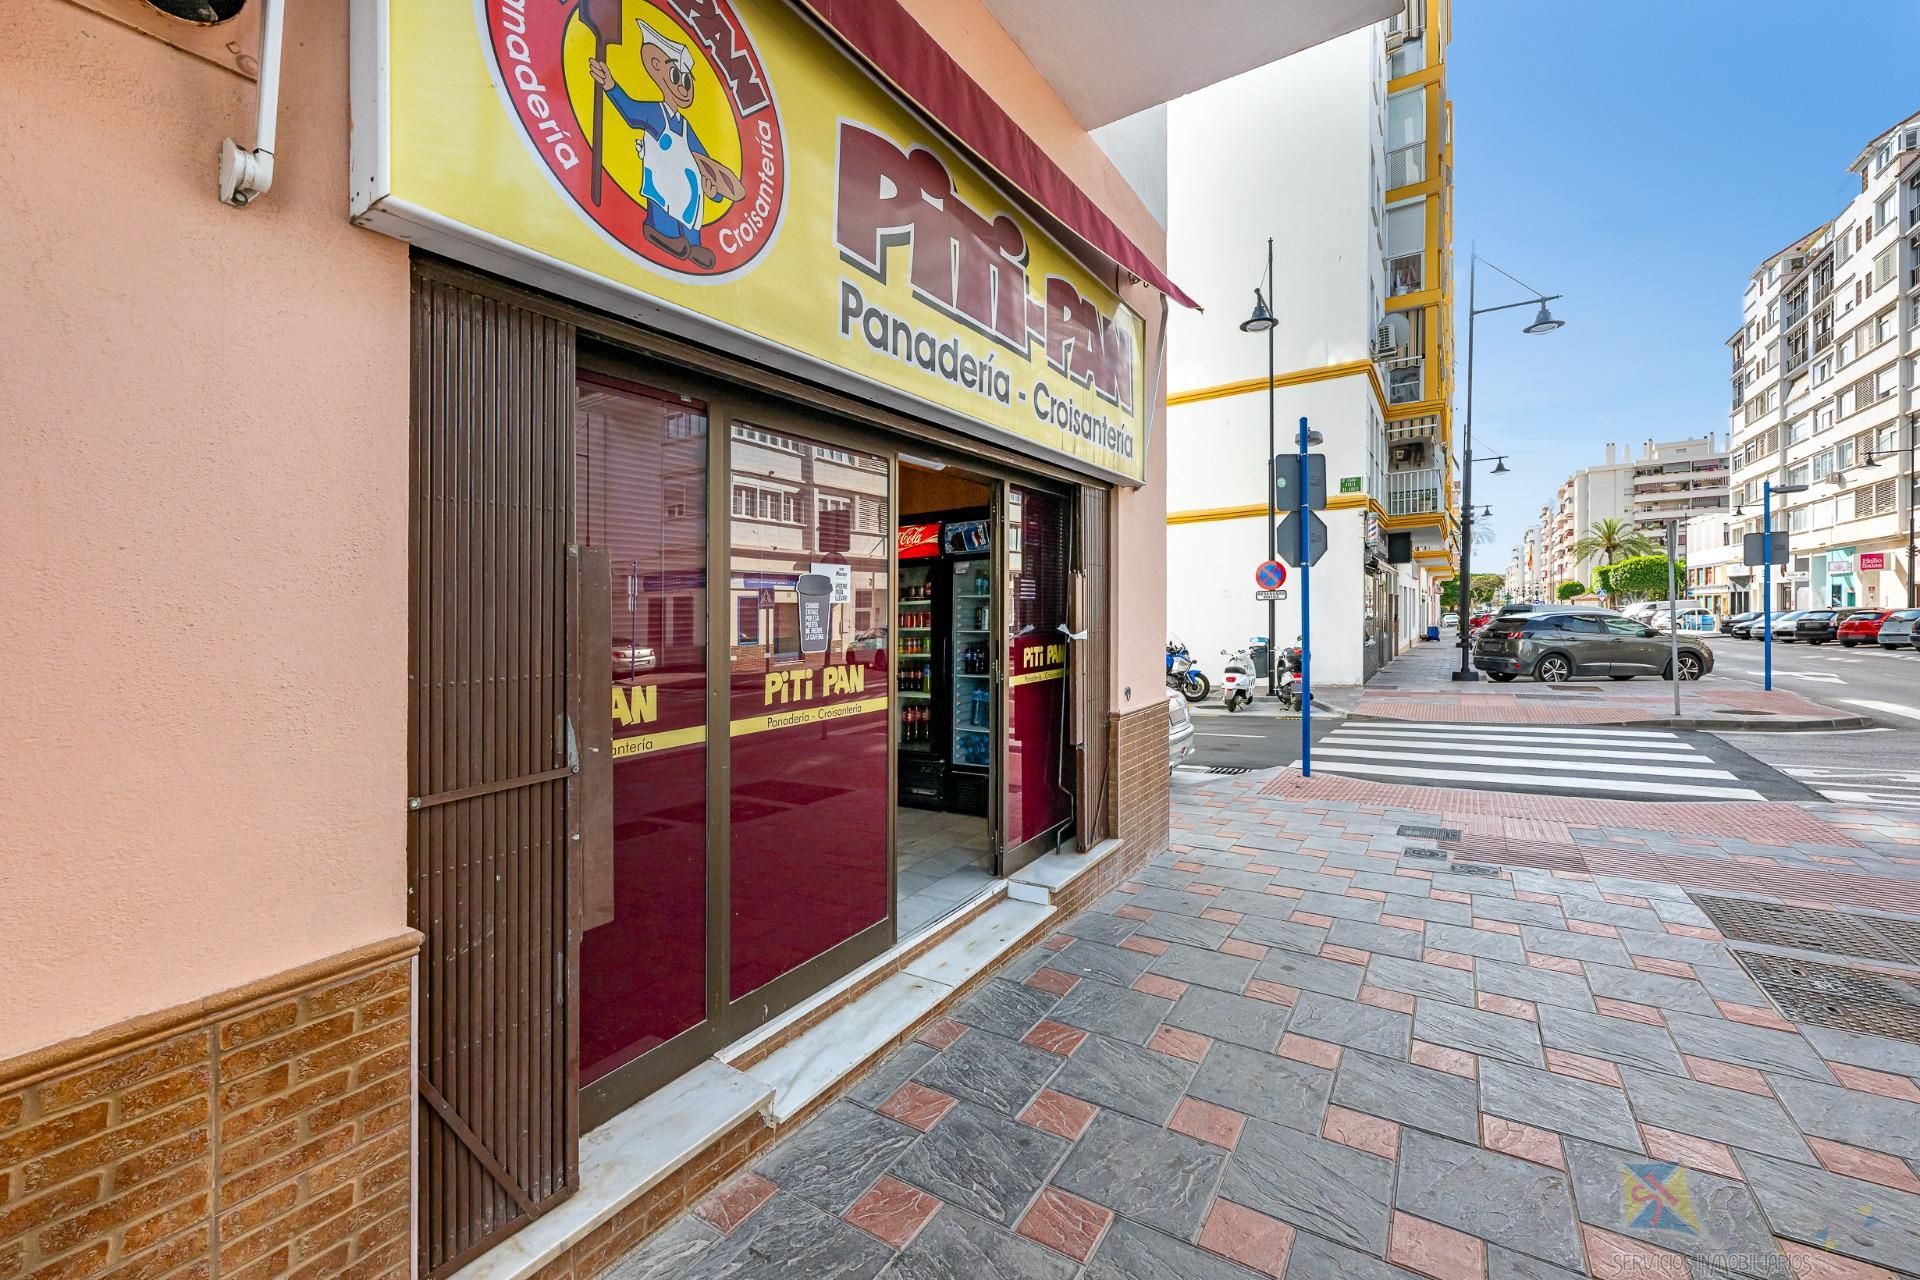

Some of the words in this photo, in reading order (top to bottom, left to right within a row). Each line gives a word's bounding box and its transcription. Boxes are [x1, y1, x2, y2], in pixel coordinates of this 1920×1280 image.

[719, 119, 776, 254] Croisantería
[839, 278, 1010, 407] Panadería
[1034, 382, 1134, 460] Croisantería
[767, 712, 810, 728] Panadería
[822, 664, 865, 698] PAN
